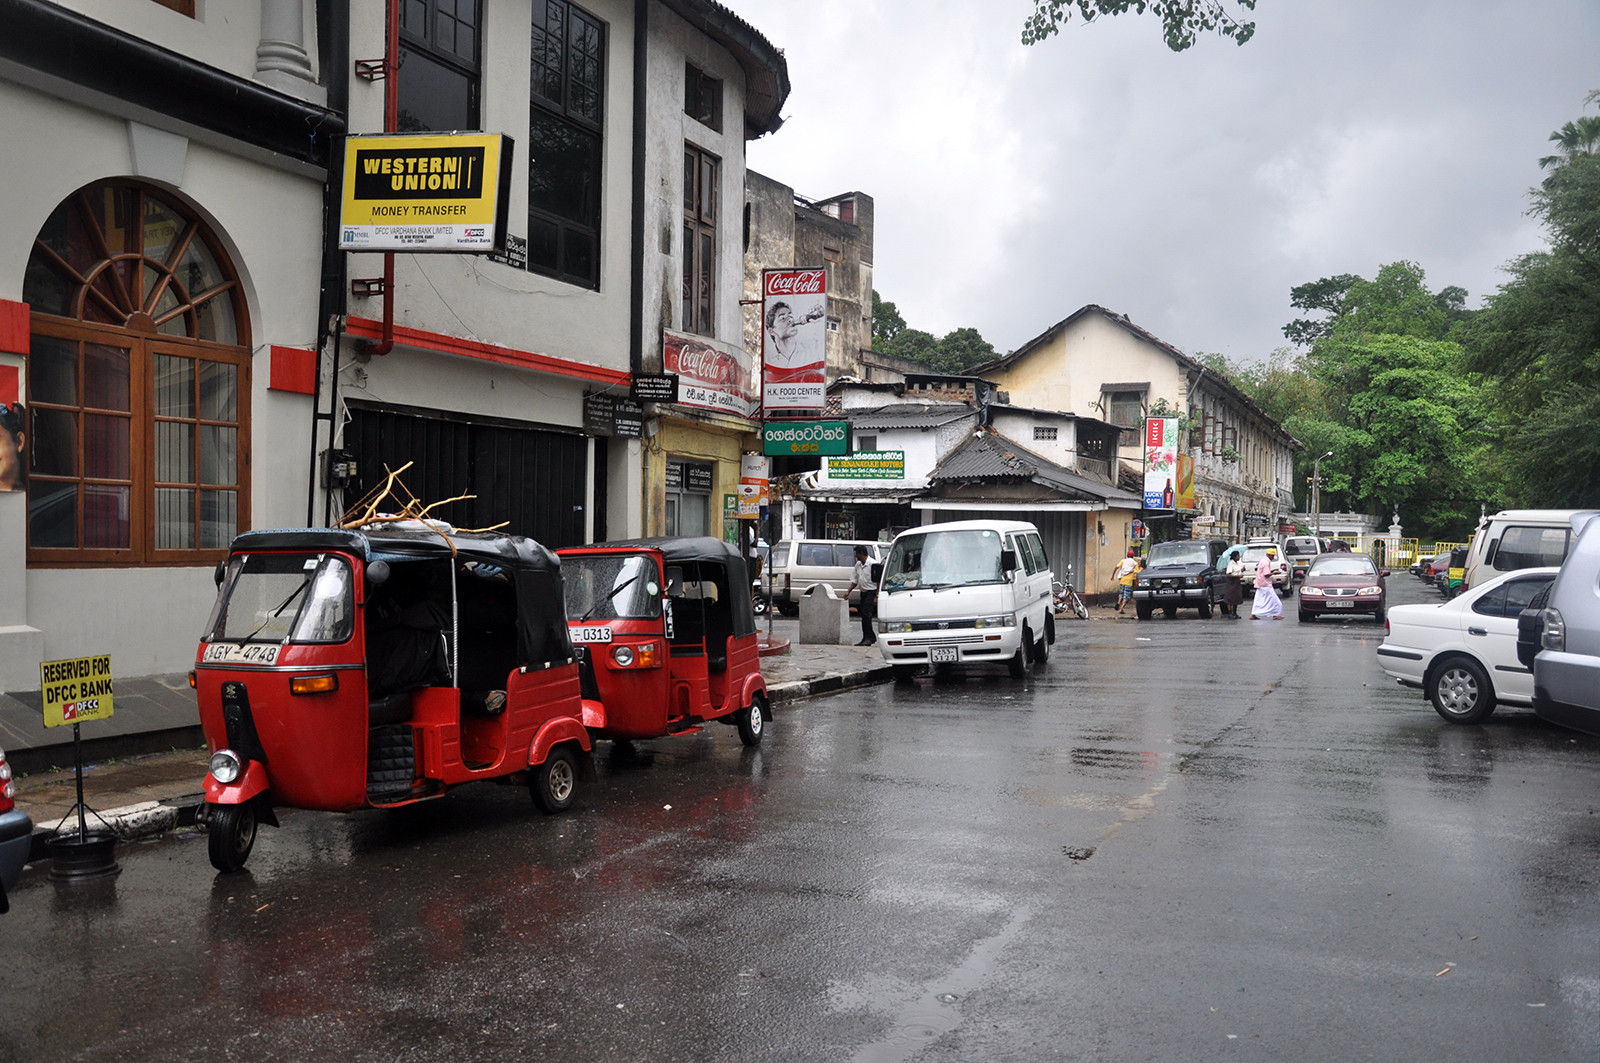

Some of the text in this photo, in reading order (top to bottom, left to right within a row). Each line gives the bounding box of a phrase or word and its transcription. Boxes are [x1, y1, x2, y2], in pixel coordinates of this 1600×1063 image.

[363, 156, 457, 175] WESTERN
[391, 174, 456, 191] UNION
[371, 205, 467, 216] MONEY TRANSFER
[375, 227, 389, 235] DFCC
[389, 227, 417, 235] VARDHANA
[418, 227, 432, 235] BANK
[767, 271, 824, 294] Coca-Cola
[780, 388, 797, 396] FOOD
[797, 387, 821, 396] CENTRE
[880, 460, 904, 468] MOTORS
[43, 657, 111, 684] RESERVED FOR
[46, 679, 113, 704] DFCC BANK
[76, 699, 99, 711] DFCC
[76, 709, 99, 718] BANK
